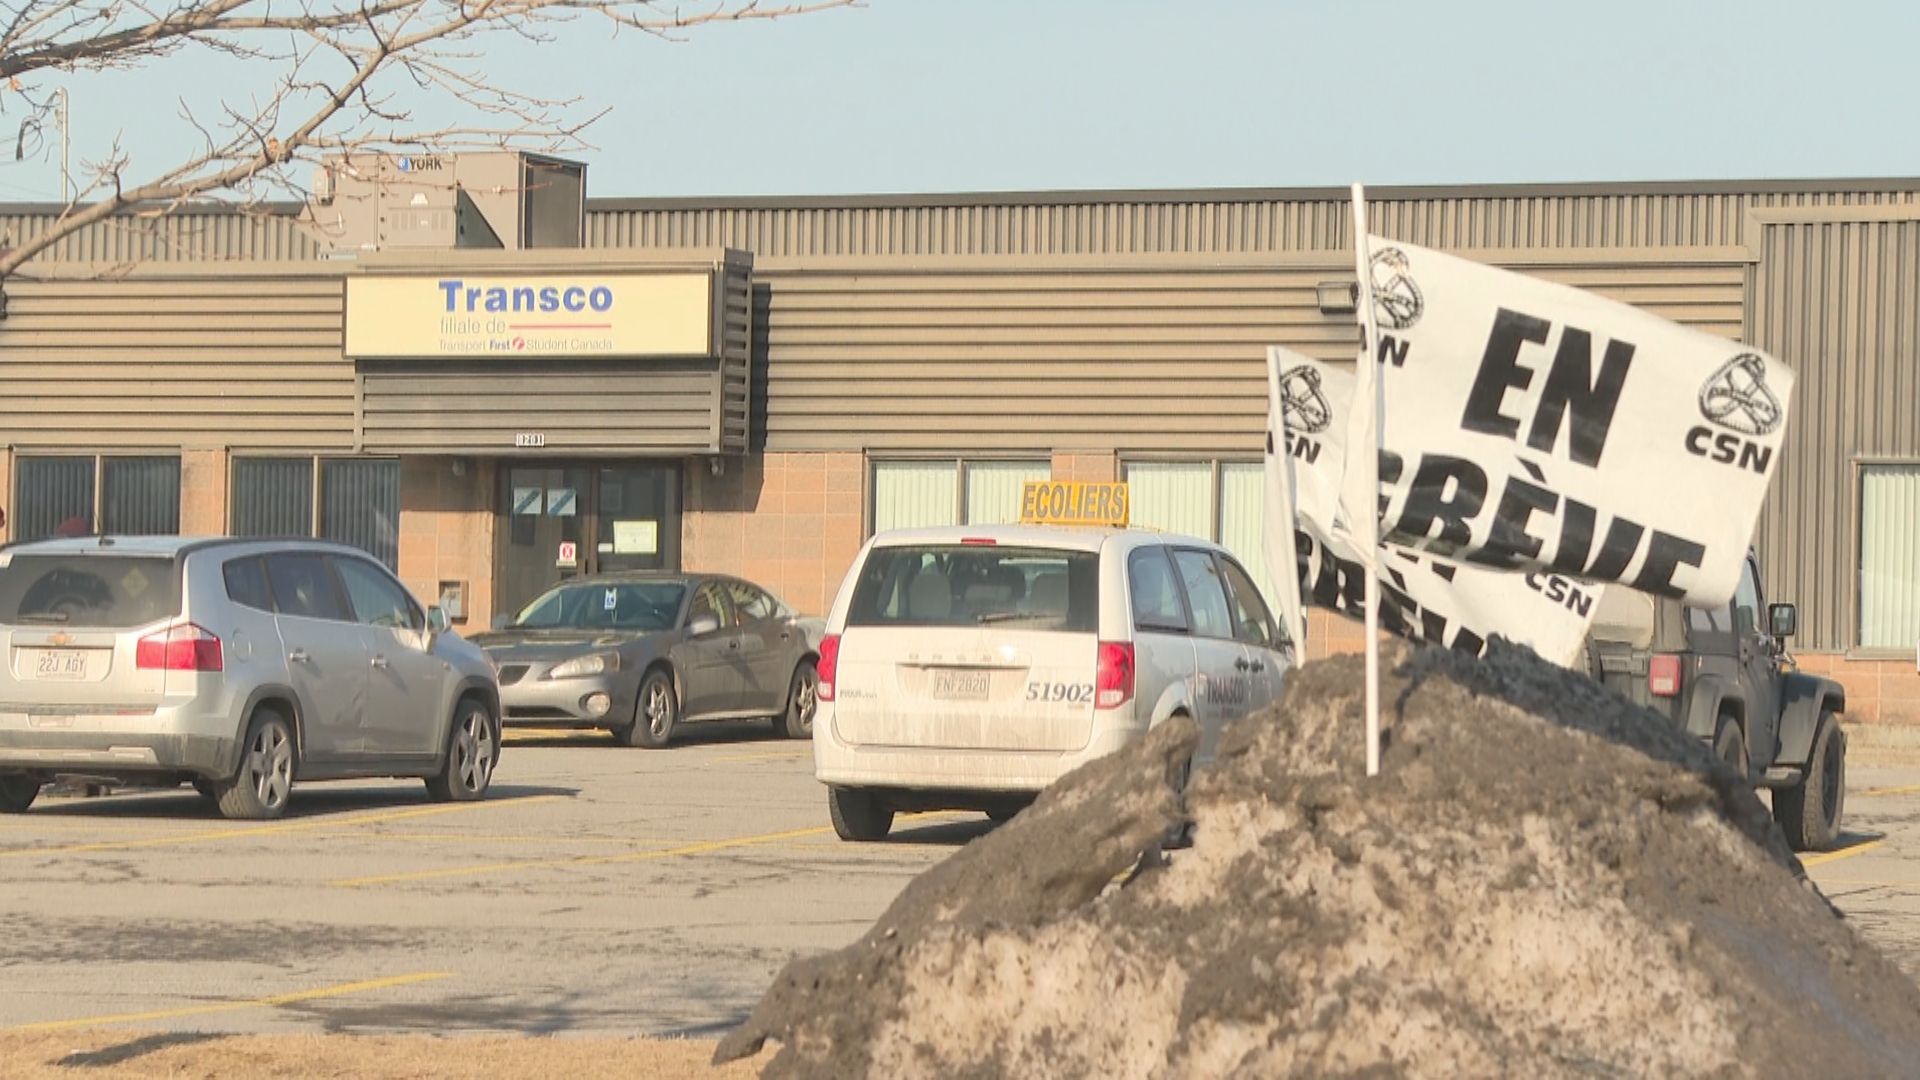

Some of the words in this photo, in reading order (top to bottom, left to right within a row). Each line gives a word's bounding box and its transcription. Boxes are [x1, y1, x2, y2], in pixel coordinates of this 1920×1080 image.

[409, 158, 442, 170] YORK
[439, 280, 613, 312] Transco
[440, 317, 480, 334] filiale
[486, 317, 506, 334] de
[489, 339, 511, 350] First
[526, 338, 568, 351] Student
[570, 338, 613, 351] Canada
[1460, 306, 1636, 469] EN
[1685, 425, 1772, 475] CSN
[1022, 484, 1125, 519] ECOLIERS
[1525, 572, 1592, 618] CSN
[1026, 681, 1094, 702] 51902
